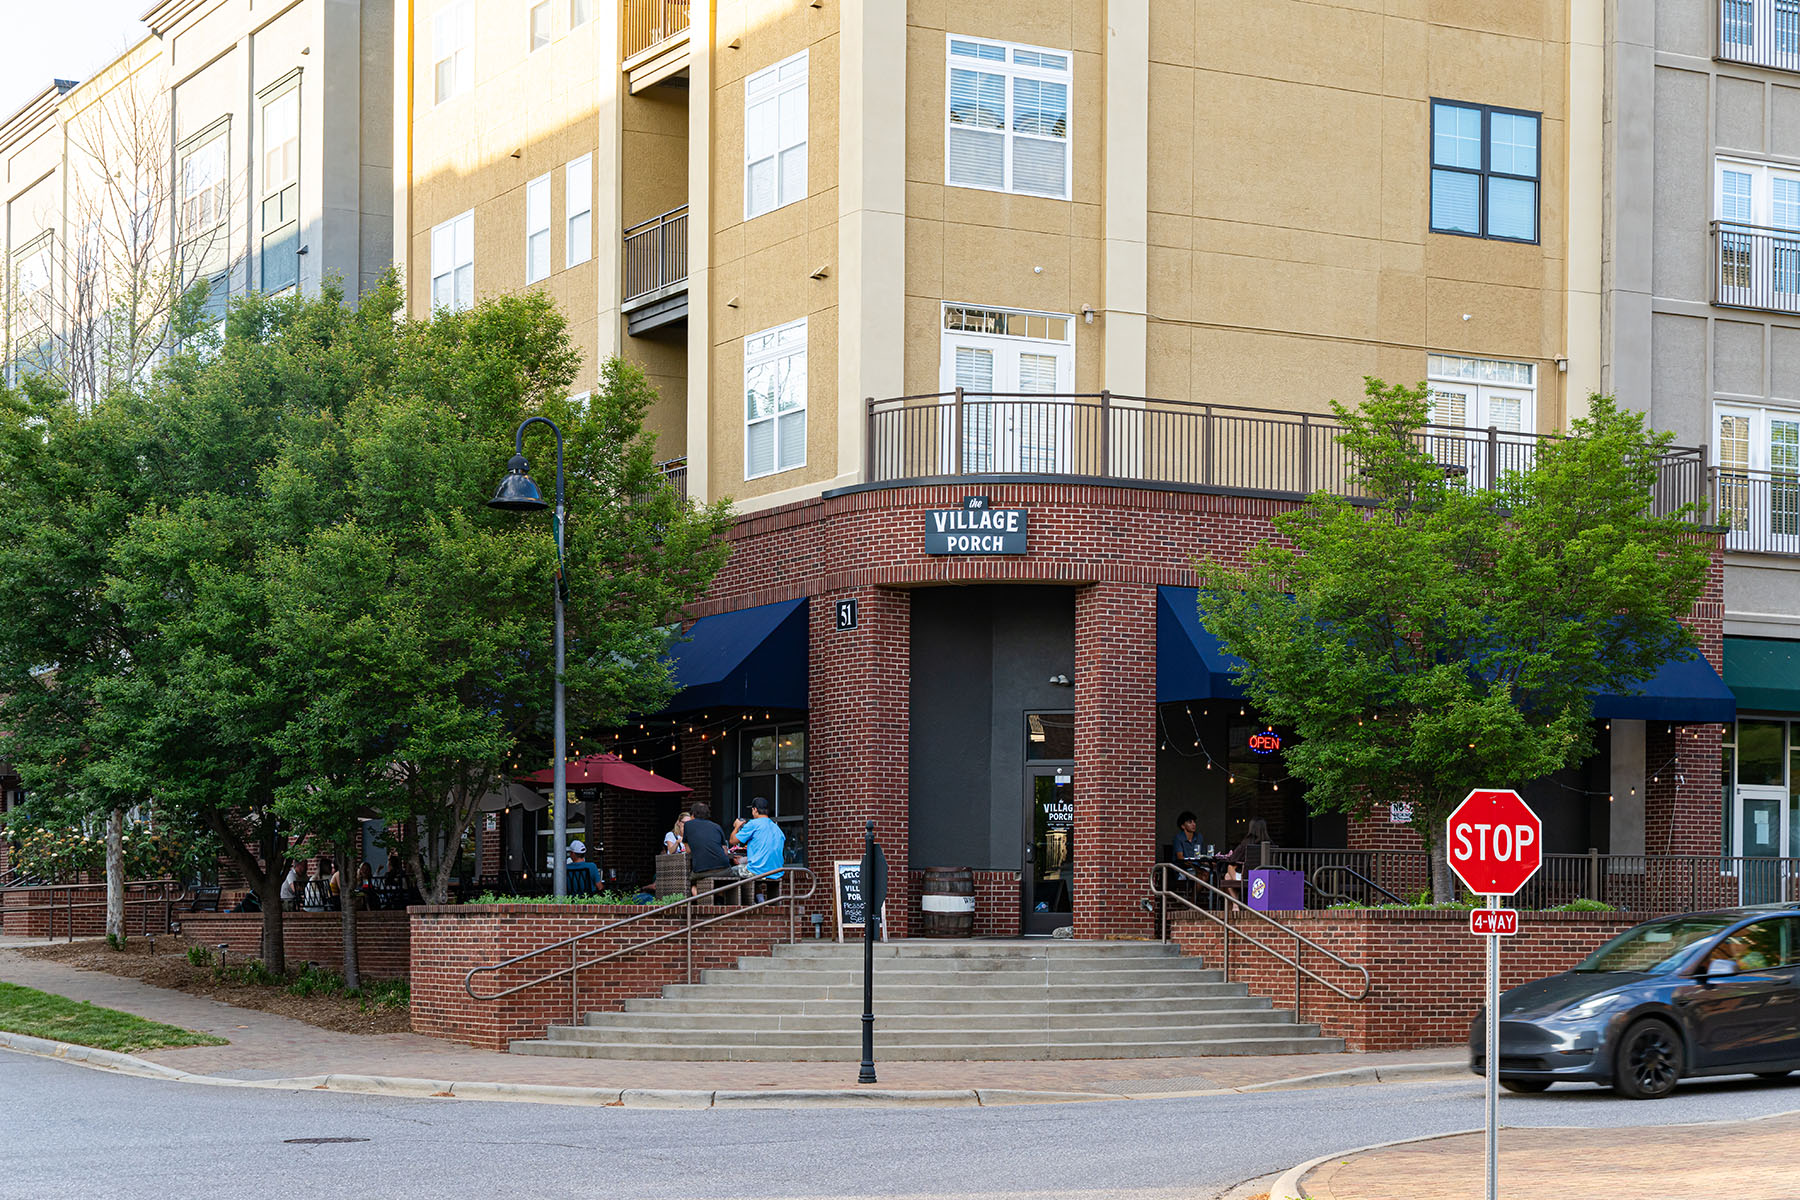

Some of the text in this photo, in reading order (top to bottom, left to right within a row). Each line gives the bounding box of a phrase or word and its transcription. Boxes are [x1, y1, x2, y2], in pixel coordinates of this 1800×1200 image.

[968, 497, 983, 509] the
[933, 510, 1020, 533] VILLAGE
[947, 535, 1004, 552] PORCH
[841, 603, 852, 627] 51
[1249, 736, 1280, 750] OPEN
[1043, 803, 1073, 813] VILLAG
[1048, 812, 1073, 821] PORCH
[1454, 822, 1535, 862] STOP
[842, 871, 860, 879] WELC
[847, 893, 862, 901] POR
[1474, 914, 1515, 930] 4-WAY
